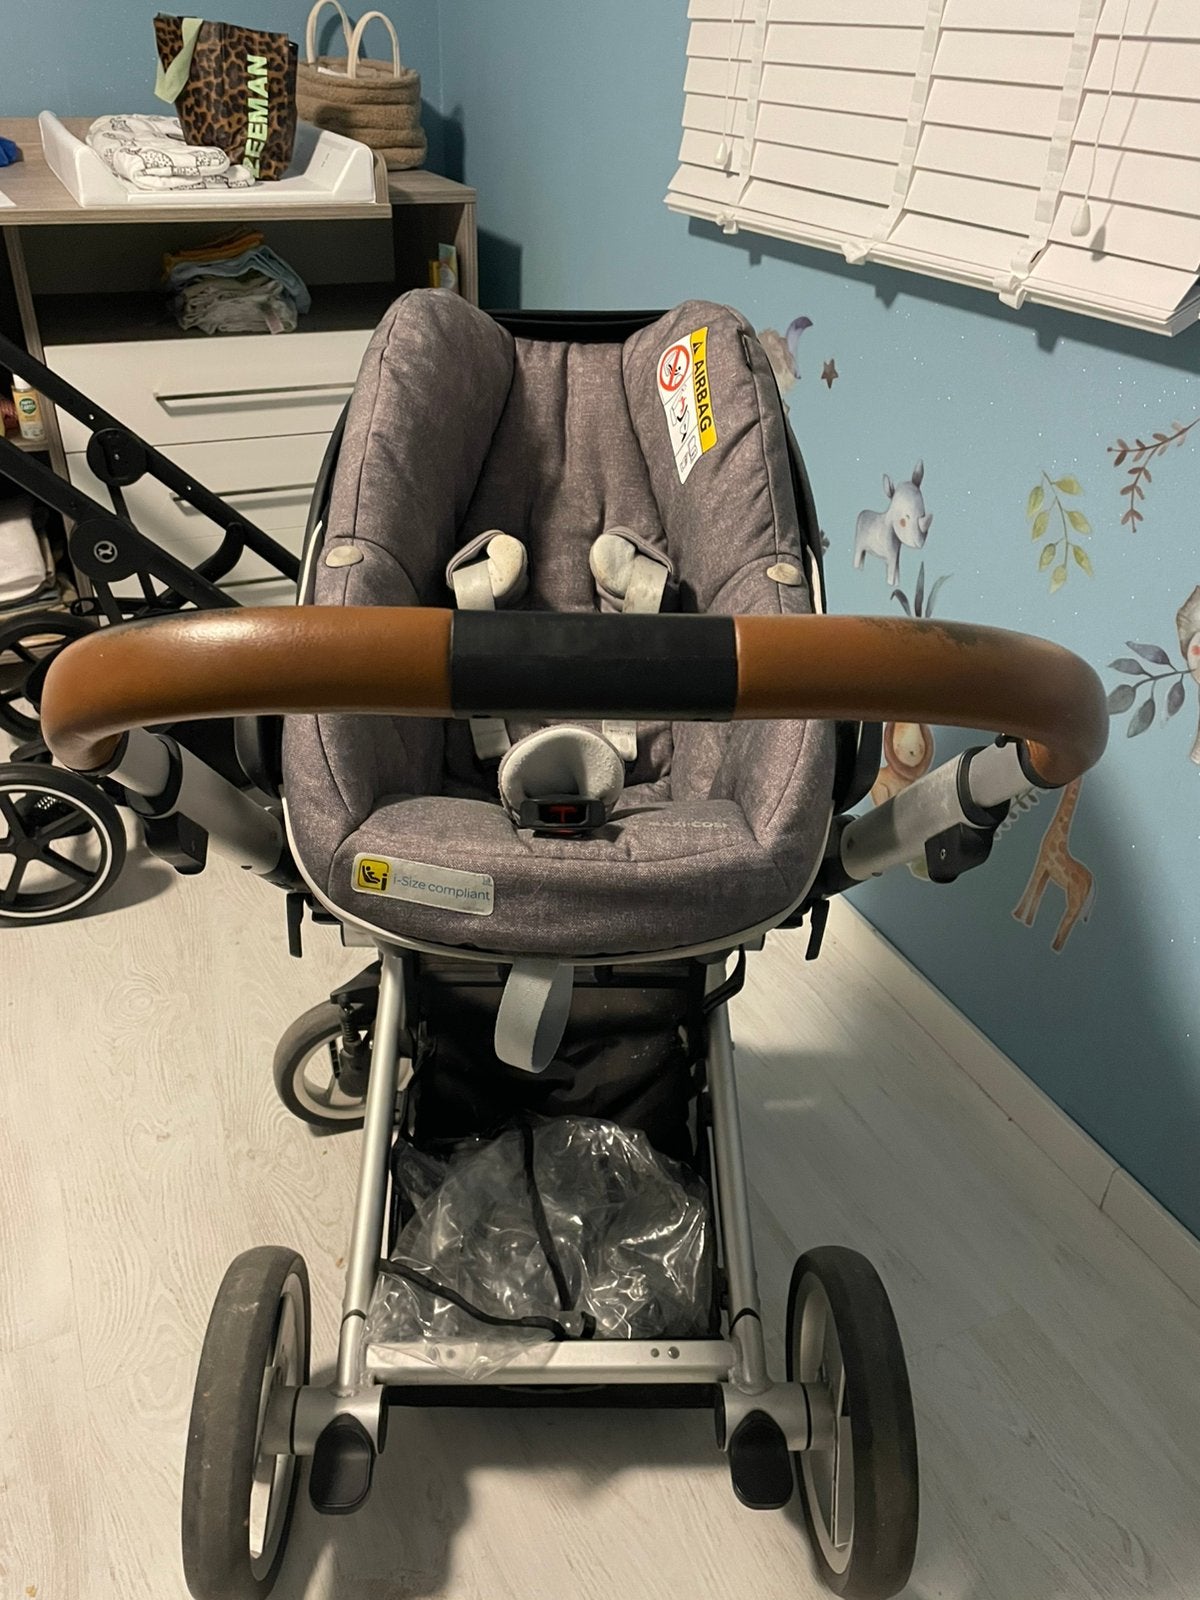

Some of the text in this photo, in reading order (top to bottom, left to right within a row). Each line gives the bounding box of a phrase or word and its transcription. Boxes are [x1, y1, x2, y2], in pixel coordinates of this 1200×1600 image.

[694, 359, 712, 433] AIRBAG
[393, 873, 491, 901] i-Size compliant
